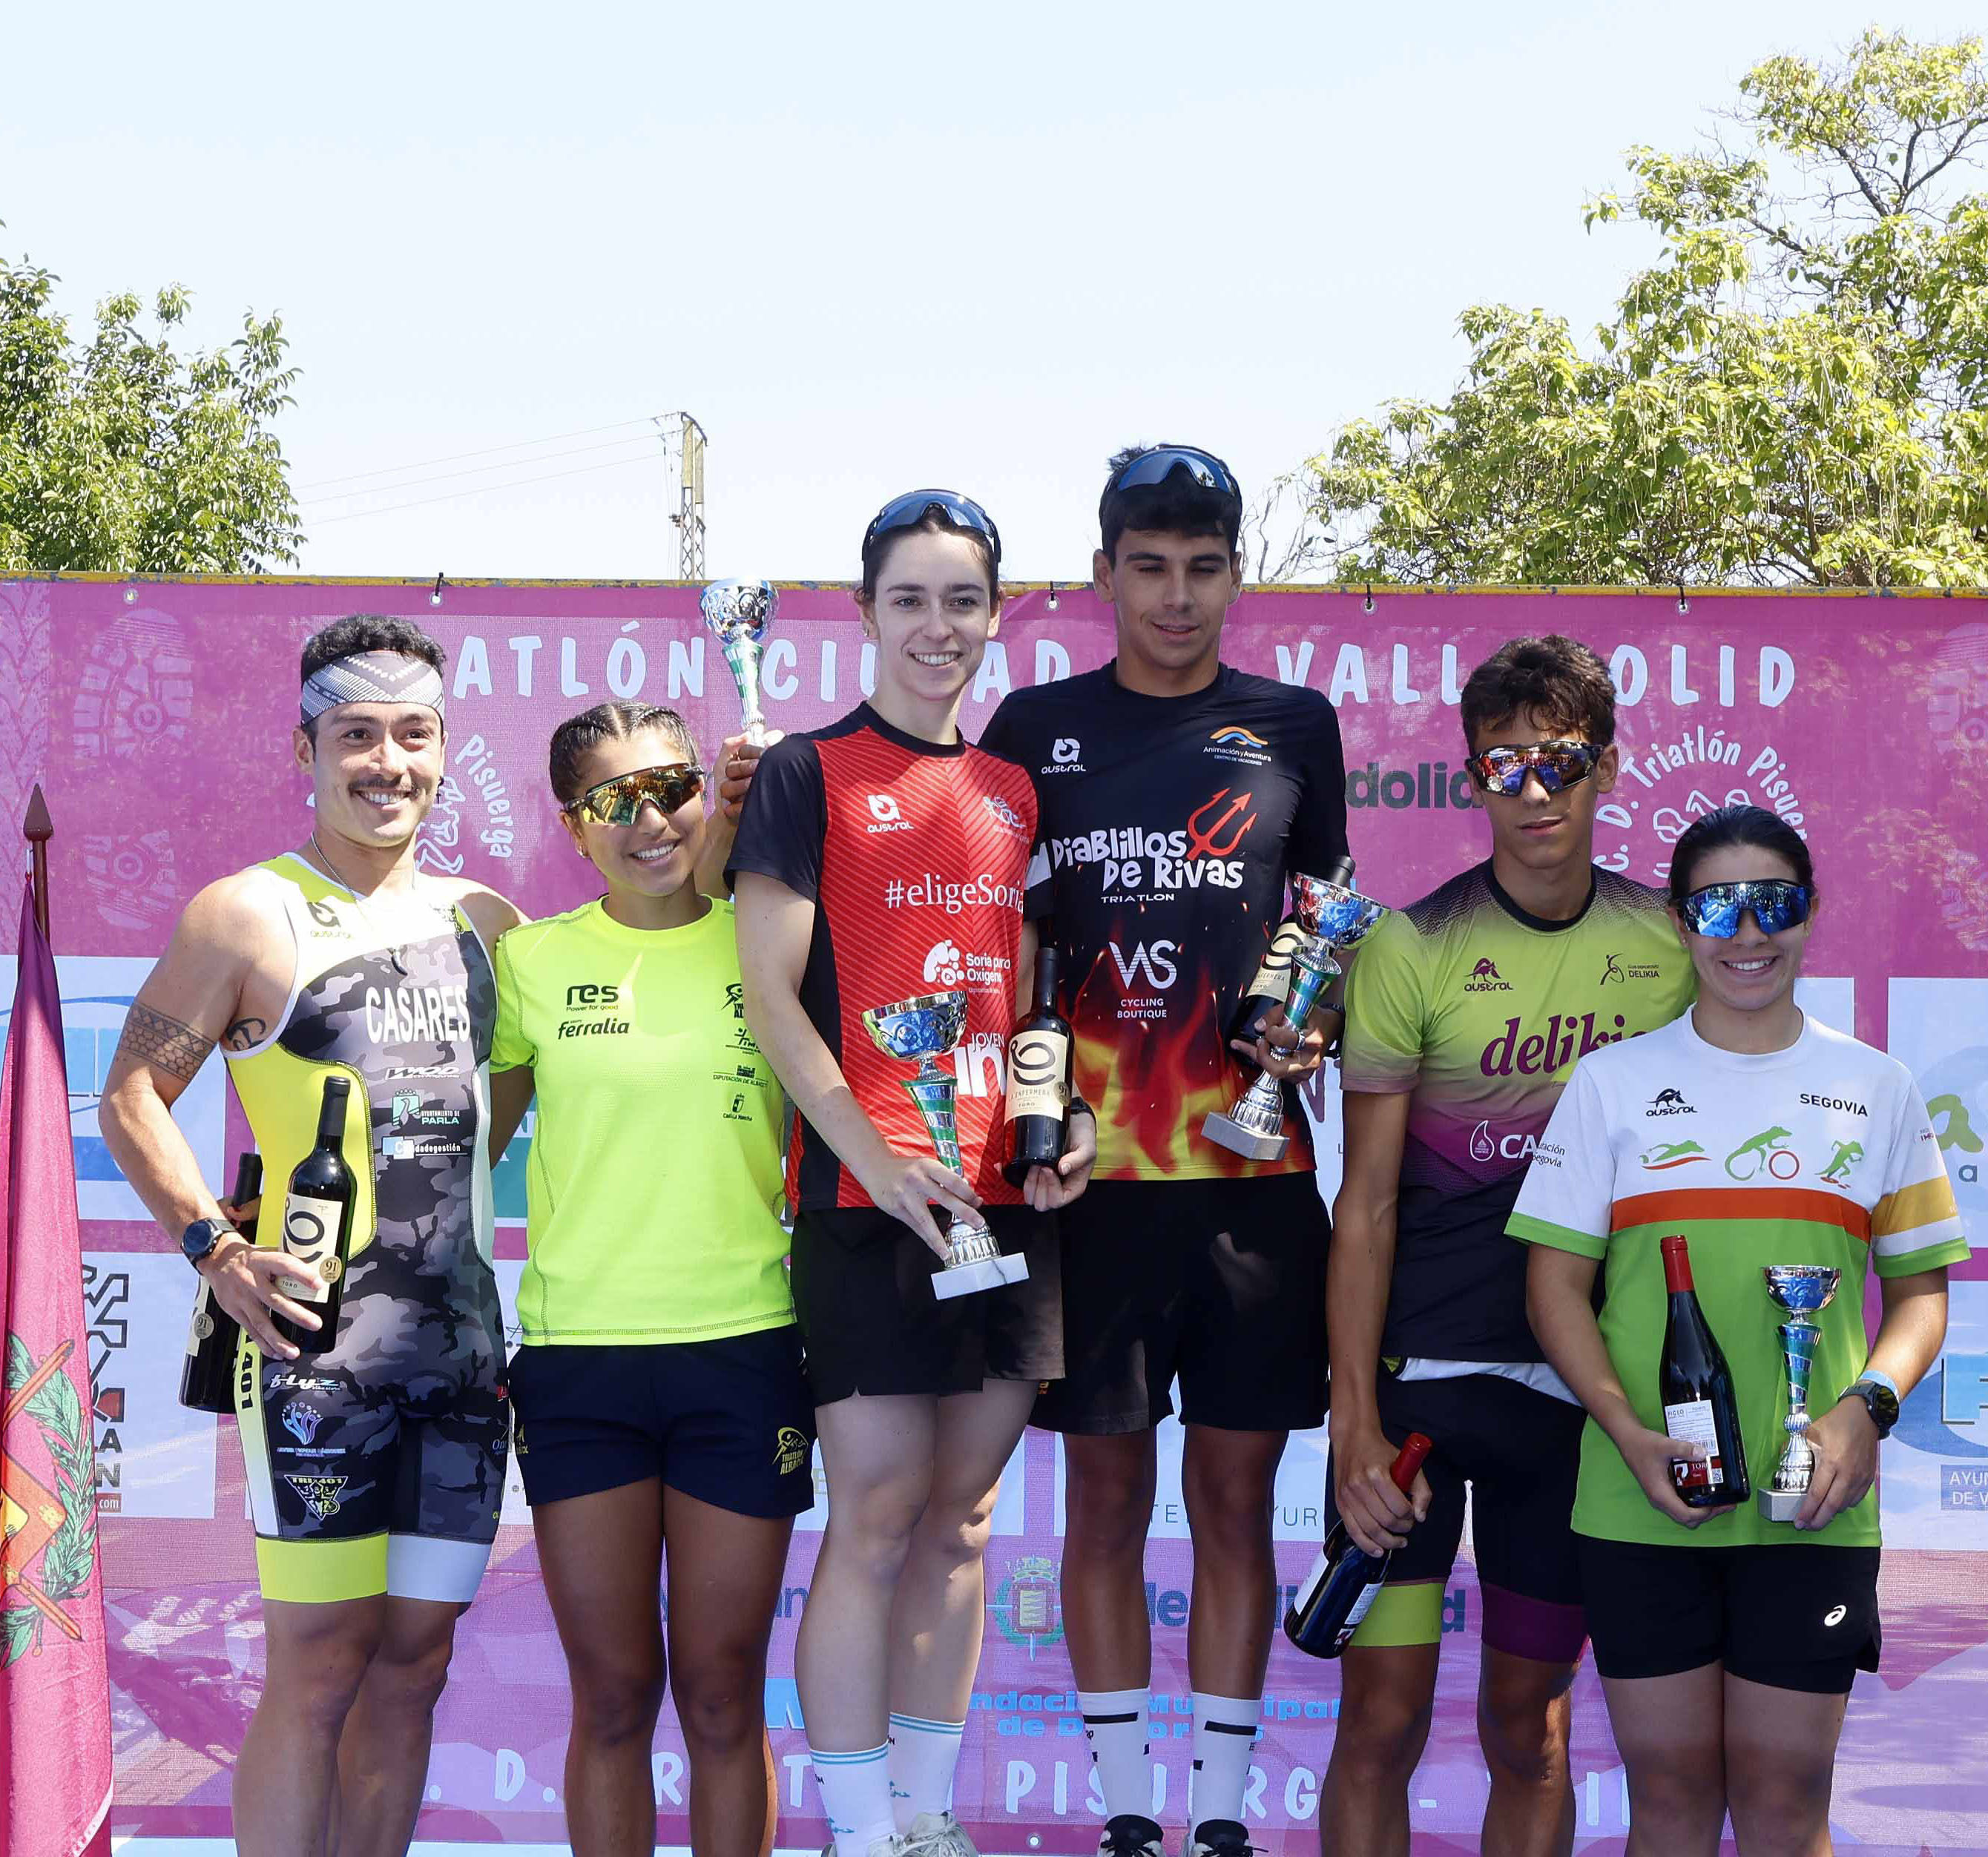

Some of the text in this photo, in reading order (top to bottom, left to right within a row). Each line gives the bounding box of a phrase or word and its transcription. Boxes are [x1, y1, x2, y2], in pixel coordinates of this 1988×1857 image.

[453, 620, 705, 699] ATLÓN
[1275, 641, 1795, 707] VALLOLID
[1041, 764, 1086, 774] austral
[1345, 761, 1476, 808] dolid
[1596, 800, 1640, 829] D.
[1622, 725, 1742, 788] Triatlón
[1747, 745, 1808, 842] Pisuer
[455, 734, 514, 859] Pisuerga
[867, 822, 914, 834] austral
[1101, 894, 1175, 903] TRIATLON
[966, 952, 992, 967] Soria
[1628, 970, 1660, 978] DELIKIA
[1464, 981, 1514, 992] austral
[567, 984, 619, 1006] res
[1120, 998, 1164, 1007] CYCLING
[365, 985, 471, 1043] CASARES
[1117, 1009, 1167, 1019] BOUTIQUE
[558, 1017, 630, 1040] ferralia
[971, 1032, 1004, 1046] JOVEN
[1480, 1012, 1650, 1077] deliki
[1646, 1106, 1698, 1117] austral
[1800, 1092, 1868, 1117] SEGOVIA
[421, 1116, 460, 1125] PARLA
[325, 1261, 338, 1273] 91
[283, 1280, 298, 1289] TORO
[240, 1351, 254, 1410] 401
[1952, 1491, 1972, 1505] DE
[970, 1689, 1341, 1721] ndaci Muipal
[998, 1714, 1045, 1737] de
